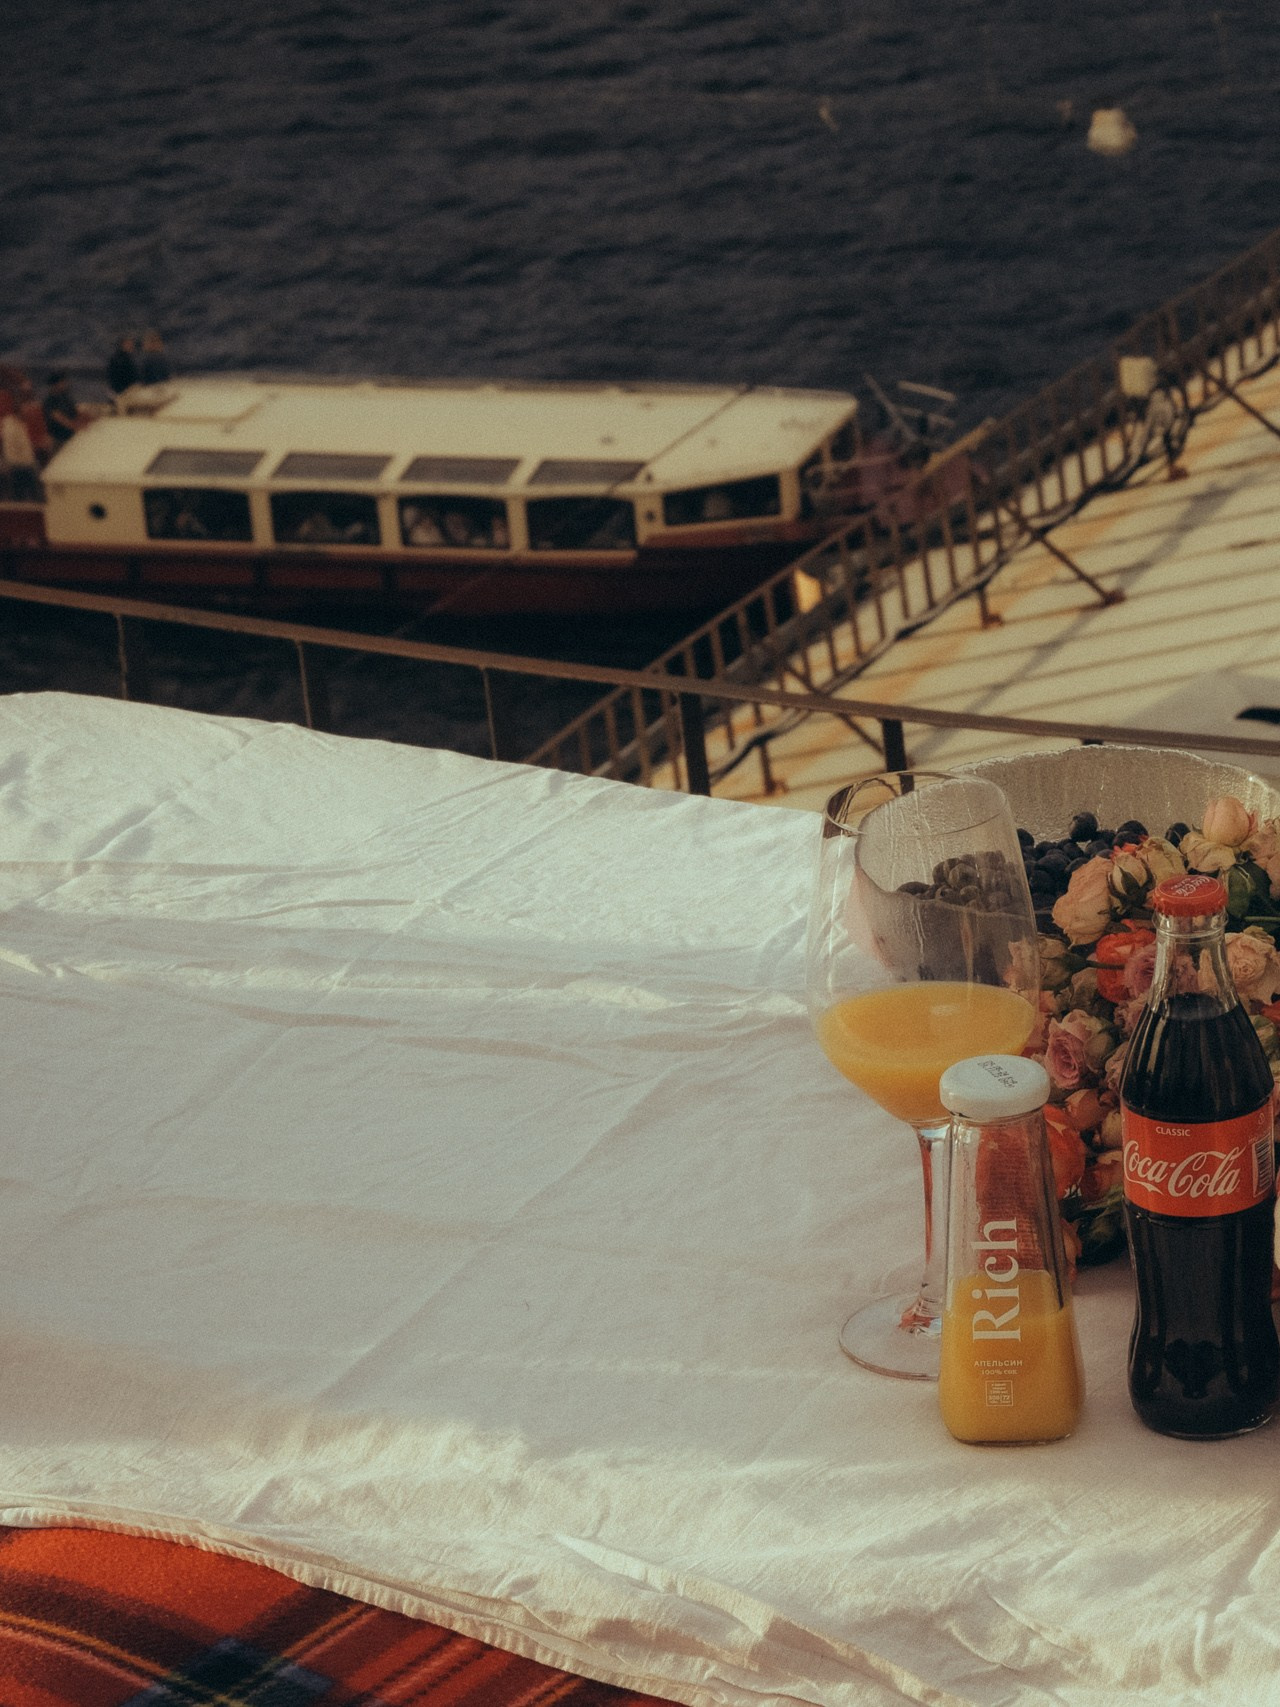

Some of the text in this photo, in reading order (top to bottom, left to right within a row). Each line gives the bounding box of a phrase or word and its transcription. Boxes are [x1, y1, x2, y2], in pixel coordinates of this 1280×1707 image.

[1155, 1126, 1191, 1137] CLASSIC
[1123, 1140, 1247, 1198] Coca-Cola
[970, 1217, 1022, 1342] Rich
